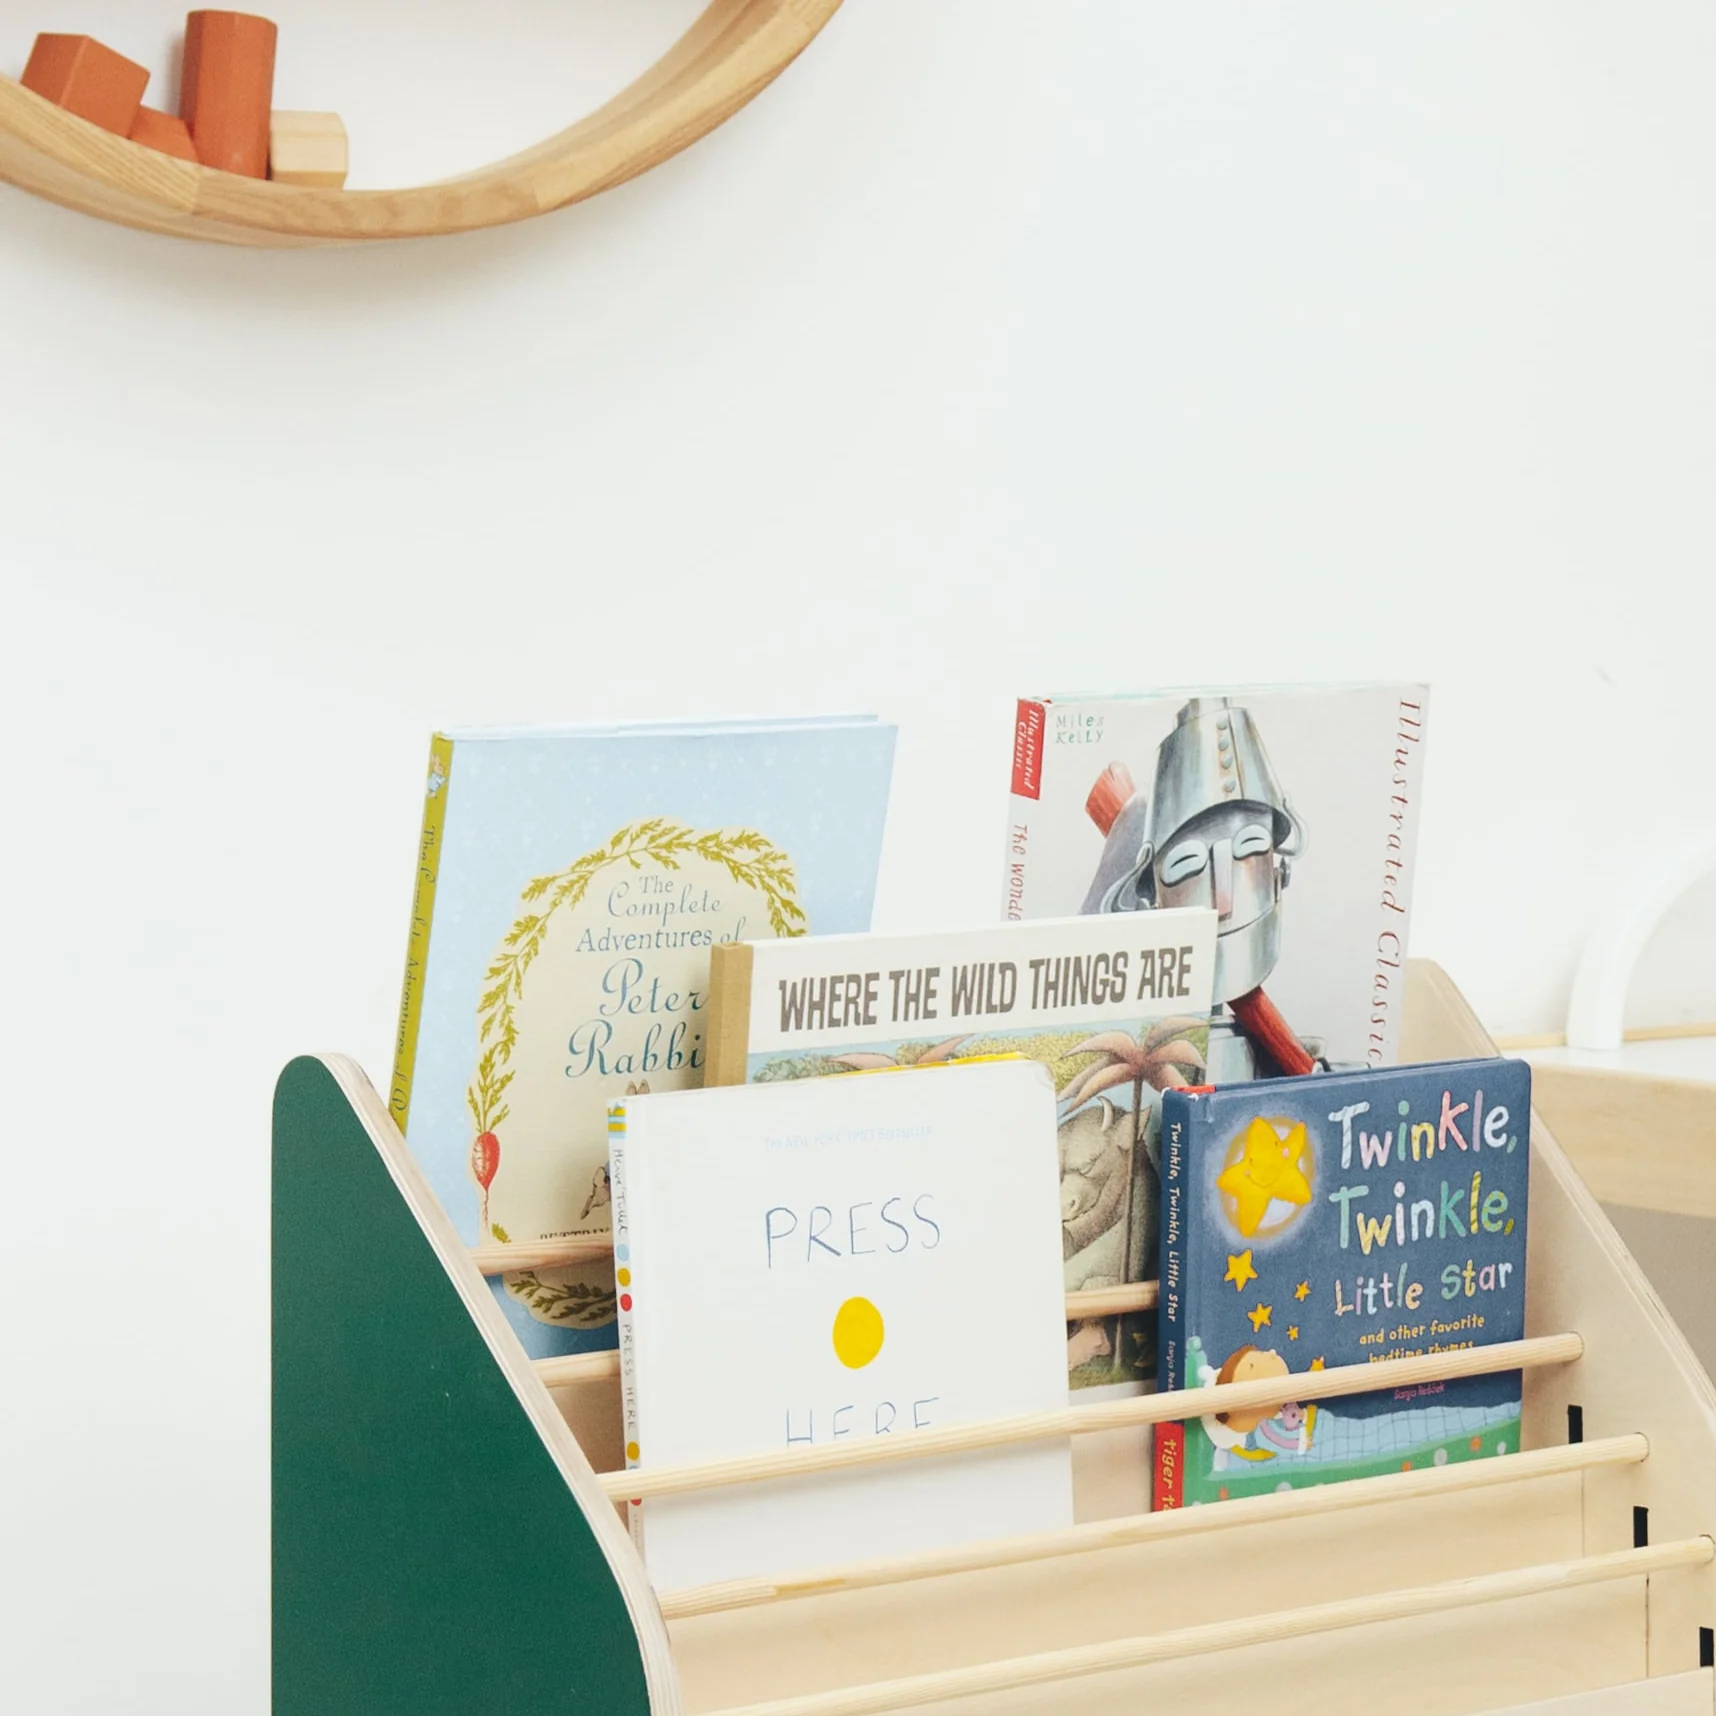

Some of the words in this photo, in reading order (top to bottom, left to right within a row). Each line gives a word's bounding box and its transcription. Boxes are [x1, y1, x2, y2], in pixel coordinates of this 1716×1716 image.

[1056, 714, 1104, 728] Miles
[1381, 699, 1421, 913] Illustrated
[1013, 824, 1028, 855] The
[608, 881, 725, 927] Complete
[639, 875, 674, 894] The
[575, 927, 713, 951] Adventures
[600, 957, 709, 1016] Peter
[778, 972, 879, 1033] WHERE
[889, 966, 940, 1022] THE
[951, 961, 1017, 1016] WILD
[1029, 951, 1128, 1010] THINGS
[1137, 945, 1193, 999] ARE
[565, 1019, 705, 1078] Rabbi
[1168, 1122, 1182, 1180] Twinkle,
[1328, 1090, 1517, 1169] Twinkle,
[765, 1193, 942, 1270] PRESS
[1168, 1186, 1180, 1244] Twinkle,
[1329, 1171, 1514, 1254] Twinkle,
[1168, 1251, 1179, 1288] Little
[1334, 1263, 1424, 1317] Little
[1441, 1259, 1512, 1300] Star
[1167, 1292, 1178, 1322] Star
[1360, 1328, 1384, 1344] and
[1389, 1325, 1426, 1340] other
[1430, 1313, 1485, 1335] favorite
[623, 1325, 634, 1376] PRESS
[626, 1387, 637, 1431] HERE
[1162, 1439, 1177, 1489] tiger
